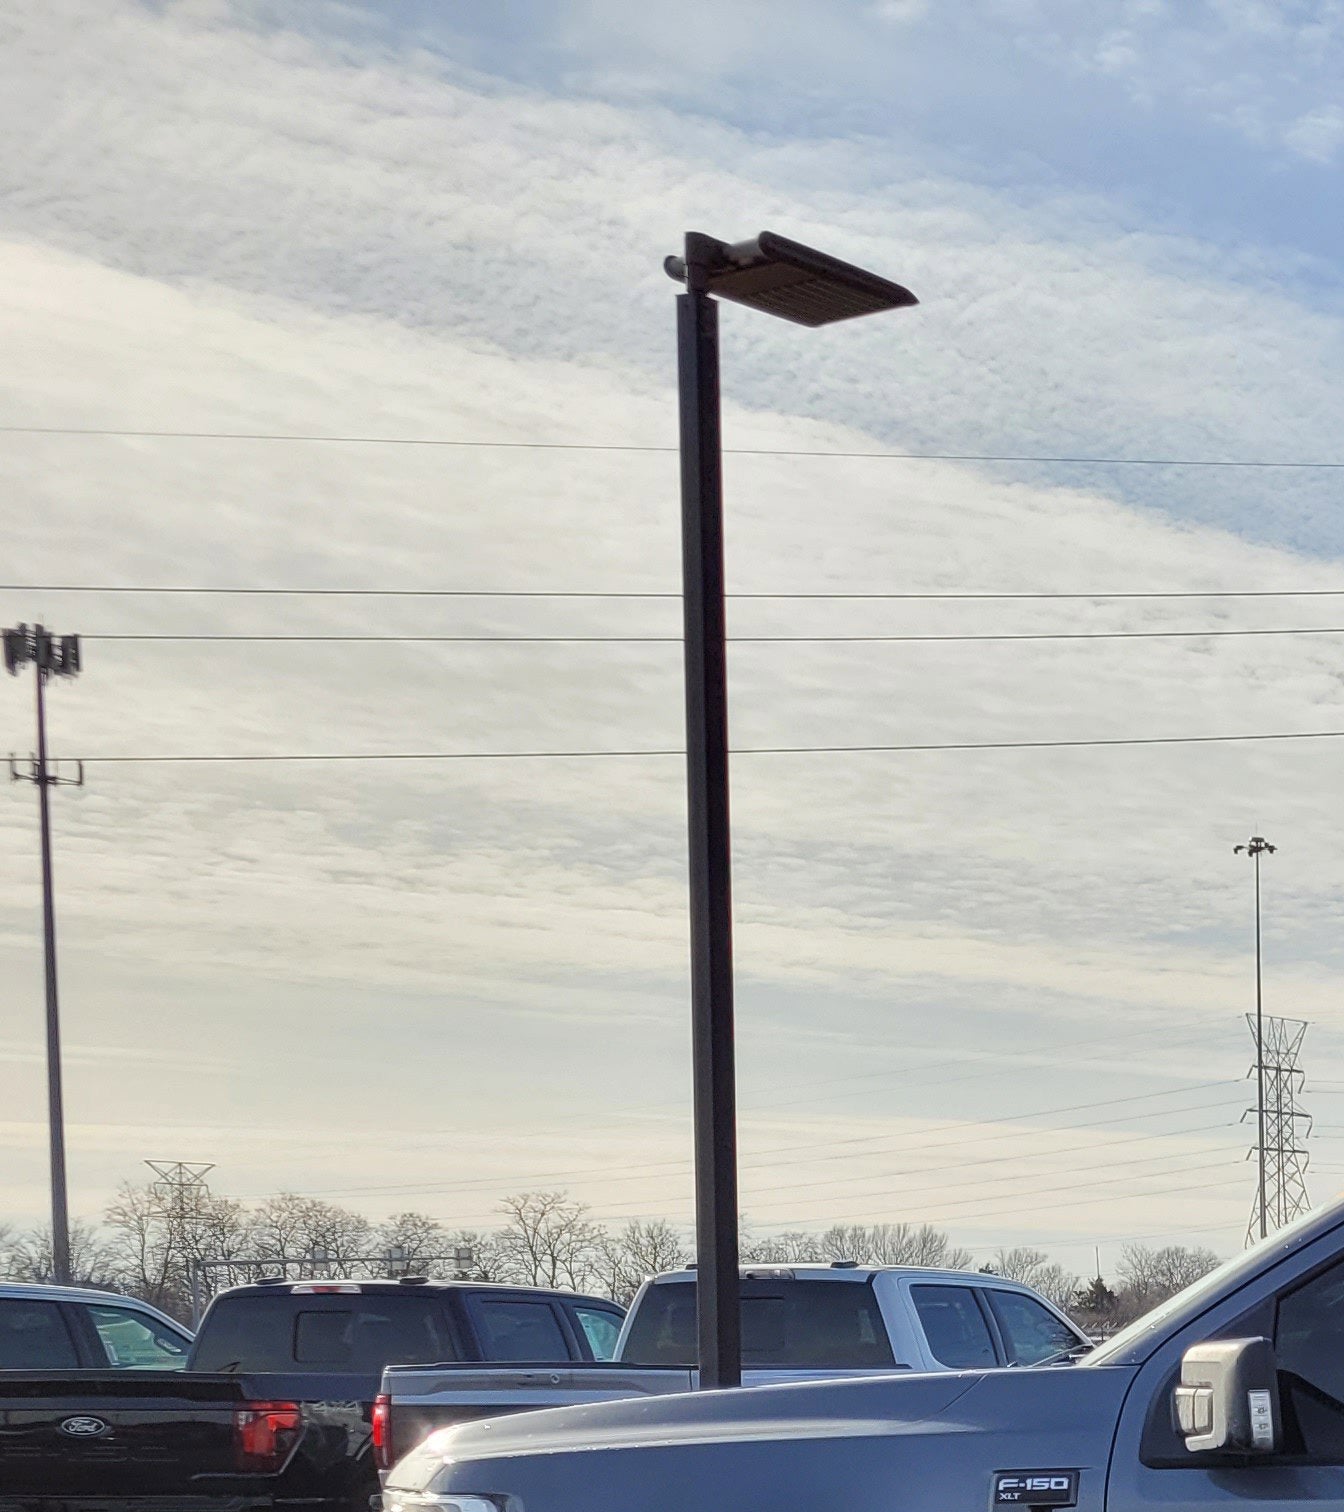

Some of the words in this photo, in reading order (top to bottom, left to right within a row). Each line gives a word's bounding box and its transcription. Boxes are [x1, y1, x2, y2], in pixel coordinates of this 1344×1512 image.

[66, 1417, 99, 1433] Ford
[998, 1477, 1069, 1491] F-150
[1000, 1492, 1021, 1501] XLT
